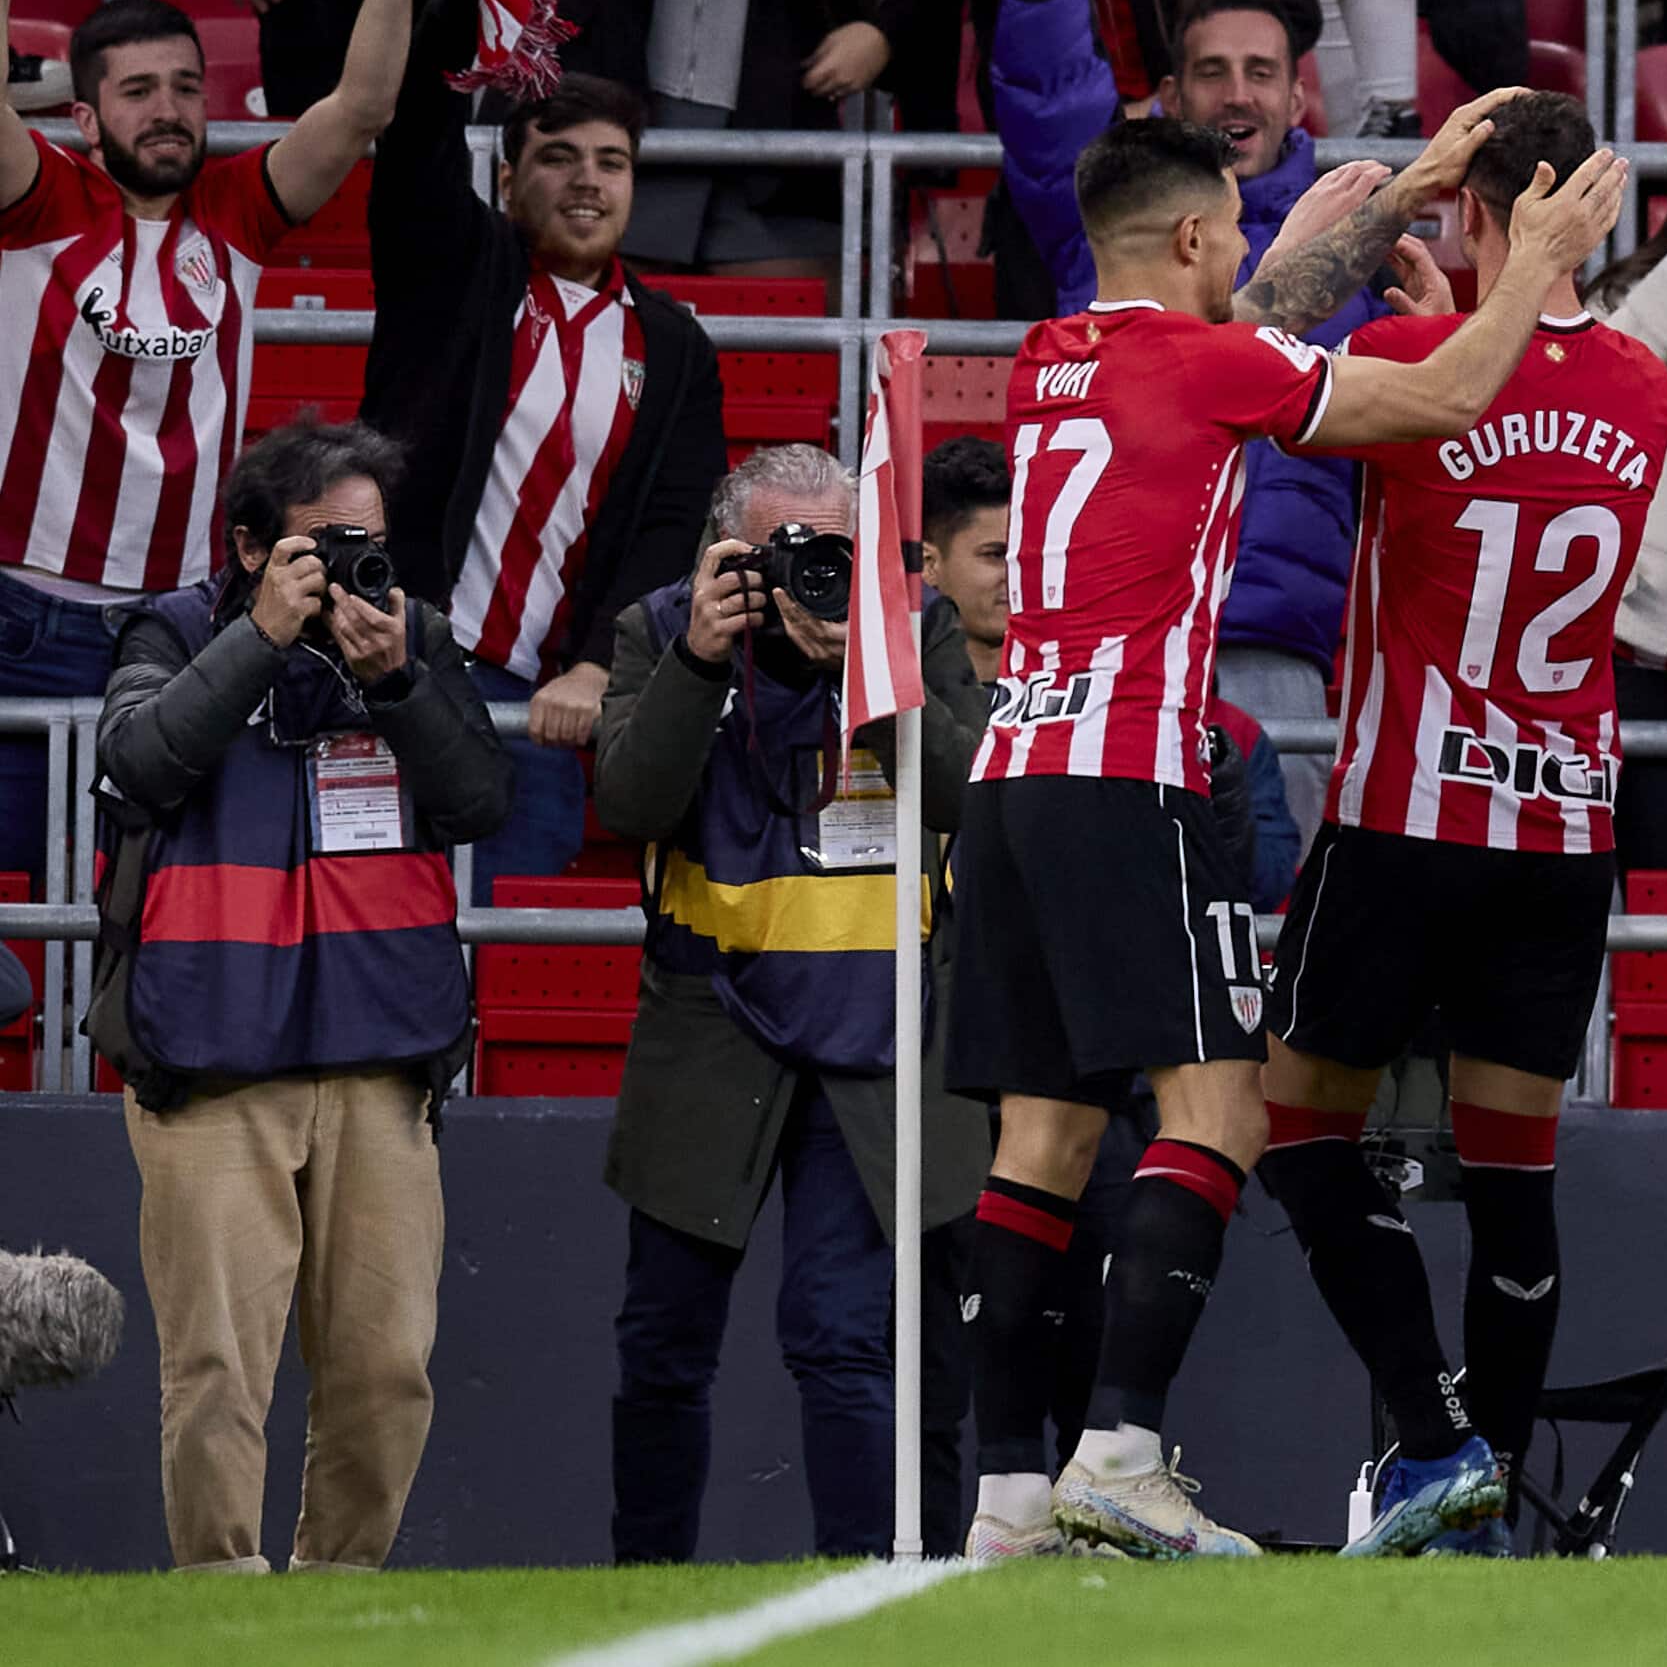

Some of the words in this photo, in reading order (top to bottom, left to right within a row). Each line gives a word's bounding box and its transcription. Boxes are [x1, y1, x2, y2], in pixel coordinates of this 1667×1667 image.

[1036, 360, 1100, 402] YURI
[1438, 410, 1651, 492] GURUZETA
[1005, 417, 1113, 616] 17
[1453, 497, 1622, 695] 12
[1205, 900, 1264, 982] 17
